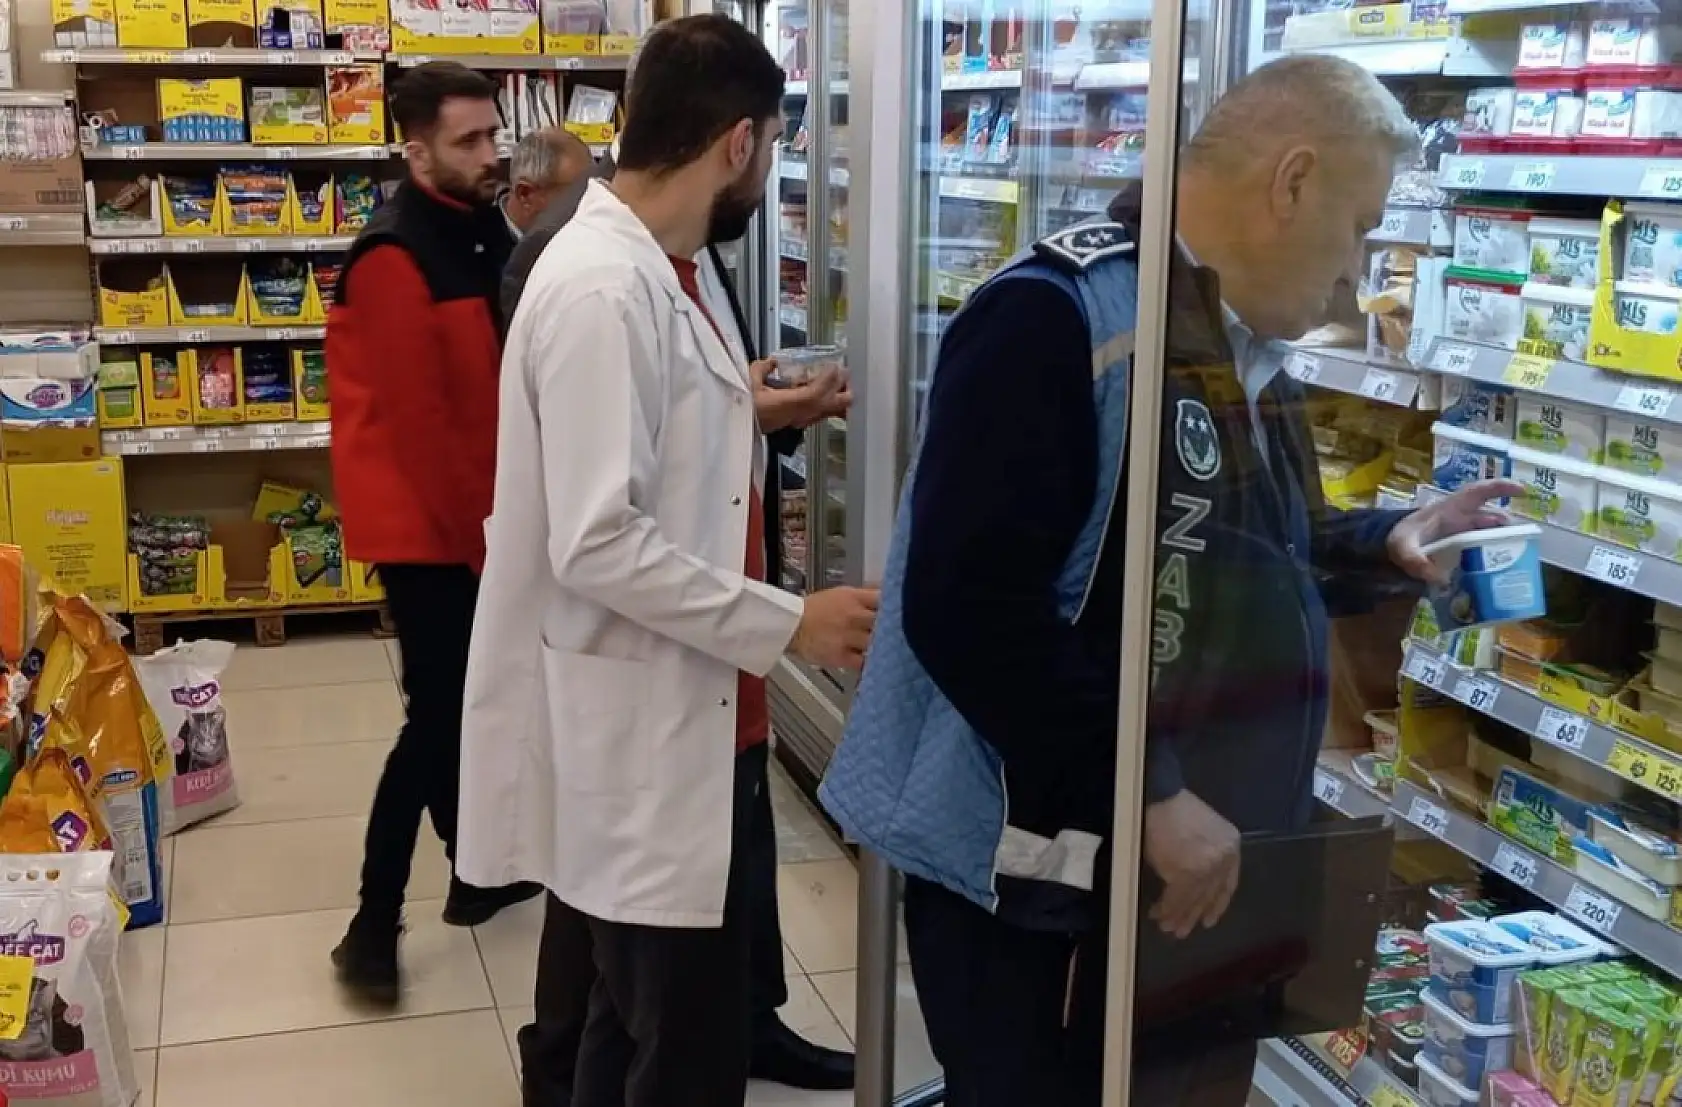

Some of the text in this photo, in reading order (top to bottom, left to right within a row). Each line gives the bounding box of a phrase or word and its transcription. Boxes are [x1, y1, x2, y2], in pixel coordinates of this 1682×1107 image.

[1556, 723, 1578, 743] 68
[1582, 901, 1606, 923] 220
[30, 943, 60, 958] CAT
